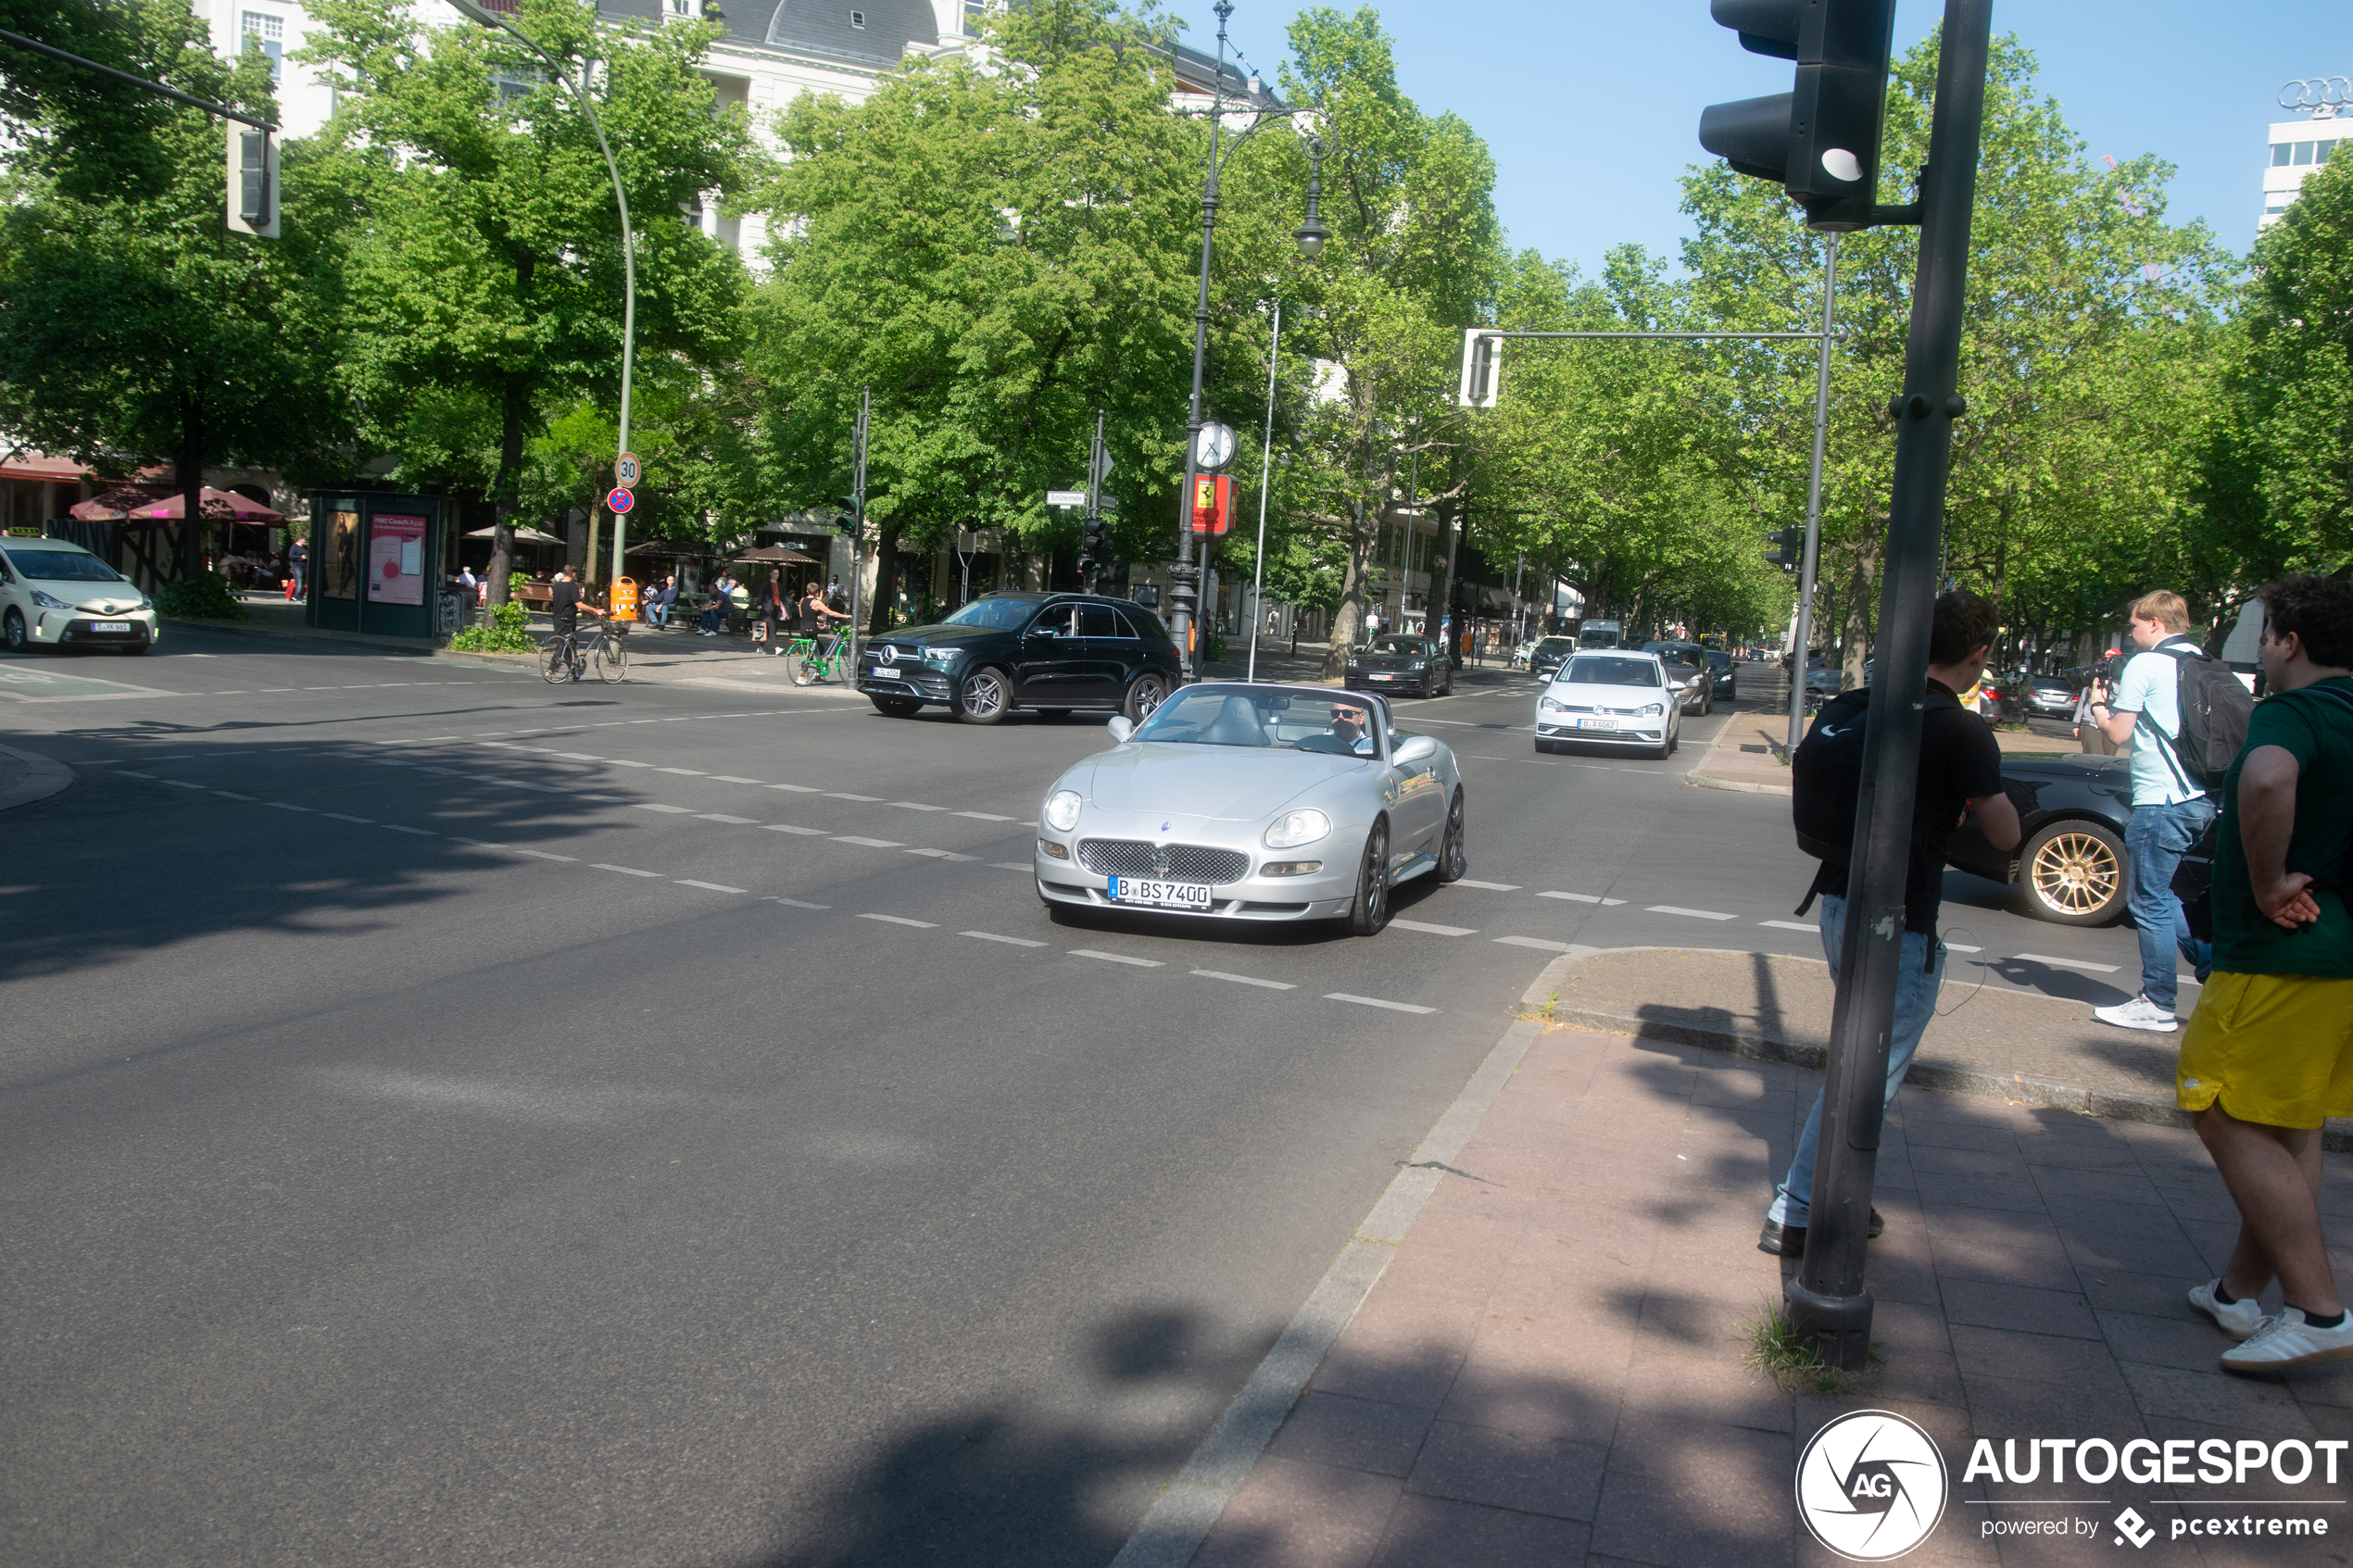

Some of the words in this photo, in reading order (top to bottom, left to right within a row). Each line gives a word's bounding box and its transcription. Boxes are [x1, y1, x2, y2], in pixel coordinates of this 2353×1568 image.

[621, 461, 635, 479] 30
[1119, 880, 1129, 896] B
[1140, 882, 1162, 899] BS
[1165, 884, 1207, 903] 7400
